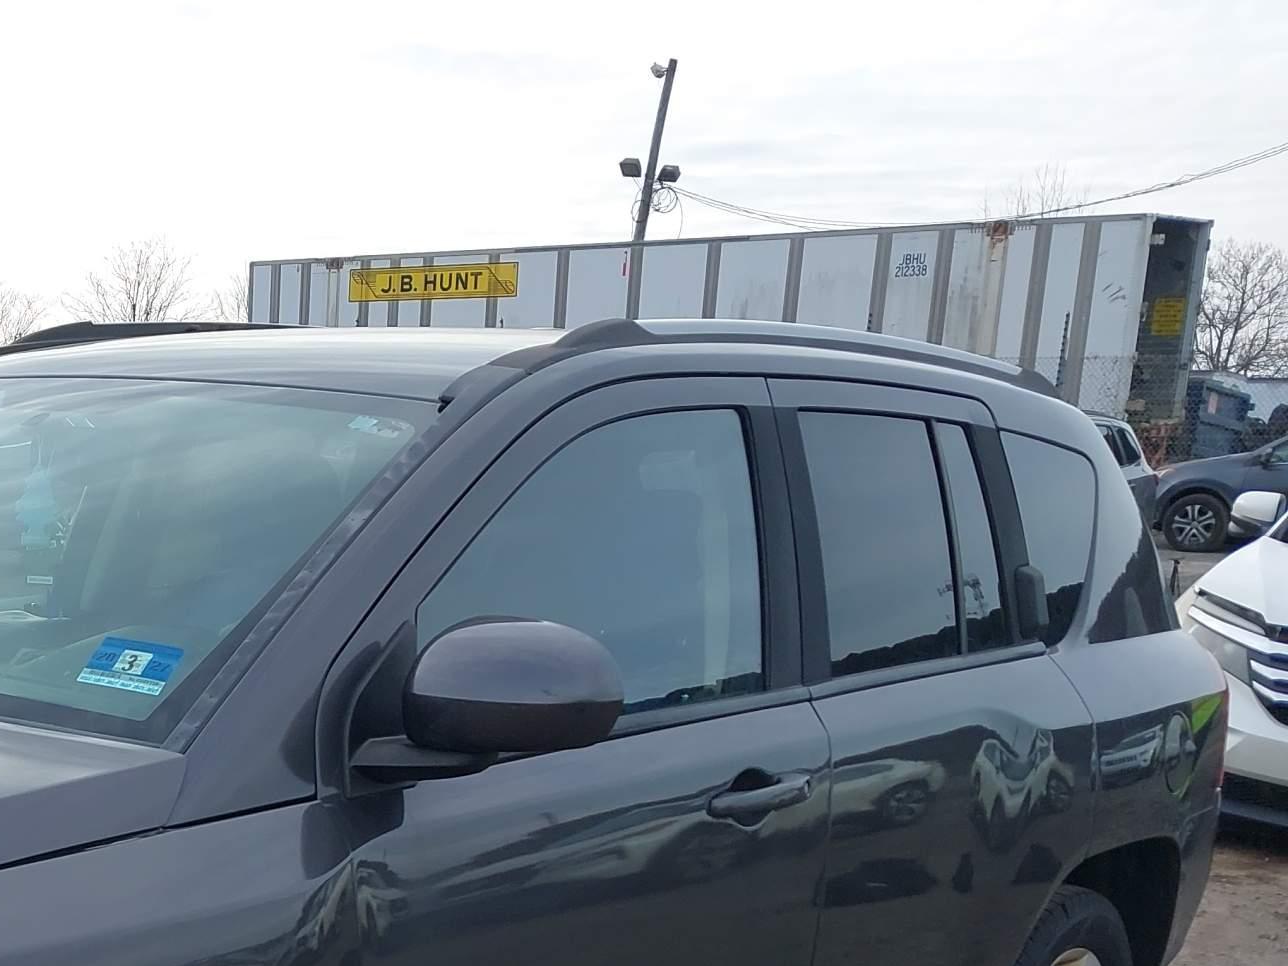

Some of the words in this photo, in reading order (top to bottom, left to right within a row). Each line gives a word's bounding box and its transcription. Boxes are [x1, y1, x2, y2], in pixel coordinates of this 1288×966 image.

[898, 252, 927, 266] JBHU
[894, 264, 928, 278] 212338
[380, 274, 418, 294] J.B.
[423, 271, 484, 293] HUNT
[121, 654, 138, 672] 3
